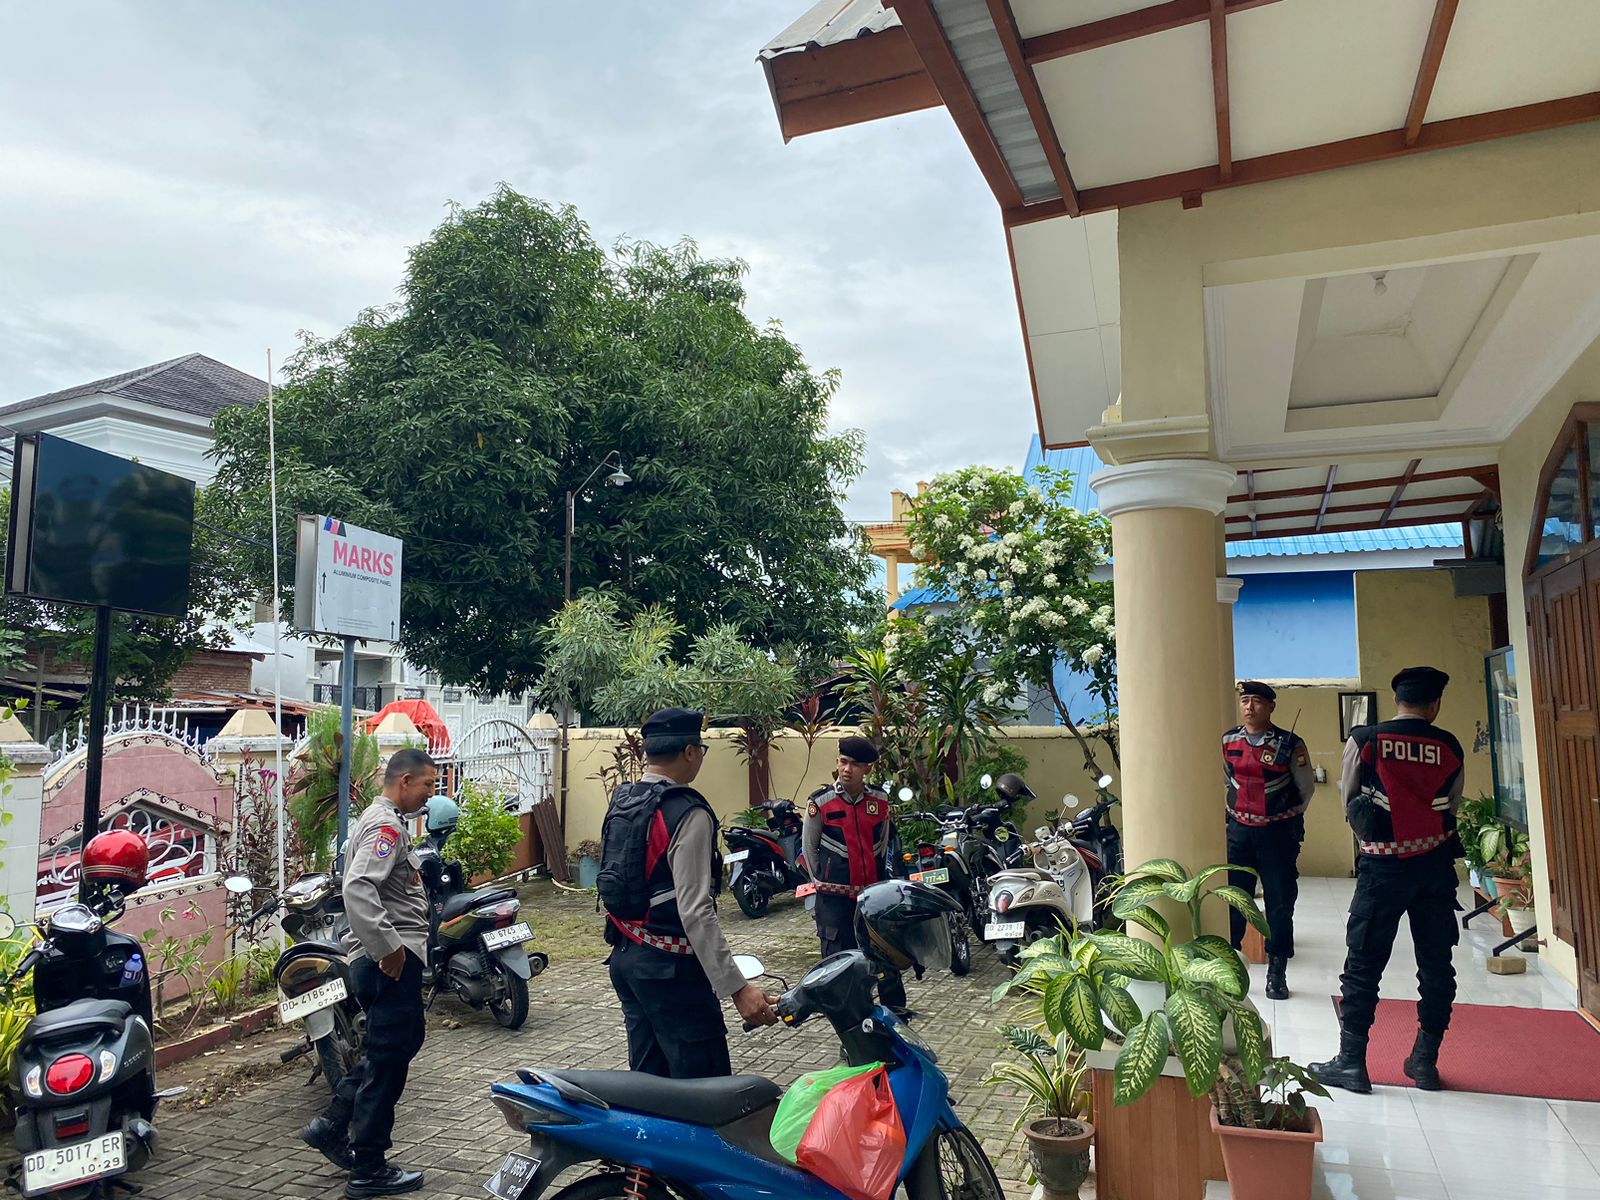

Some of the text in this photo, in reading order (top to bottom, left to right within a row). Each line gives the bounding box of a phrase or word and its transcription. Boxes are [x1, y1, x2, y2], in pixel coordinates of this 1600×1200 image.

[333, 540, 393, 577] MARKS
[357, 574, 379, 584] COMPOSITE
[380, 579, 392, 587] PANEL
[1382, 740, 1440, 765] POLISI
[497, 926, 516, 938] 6745
[282, 980, 343, 1012] DD 4186 DH
[27, 1136, 120, 1173] DD 5017 ER
